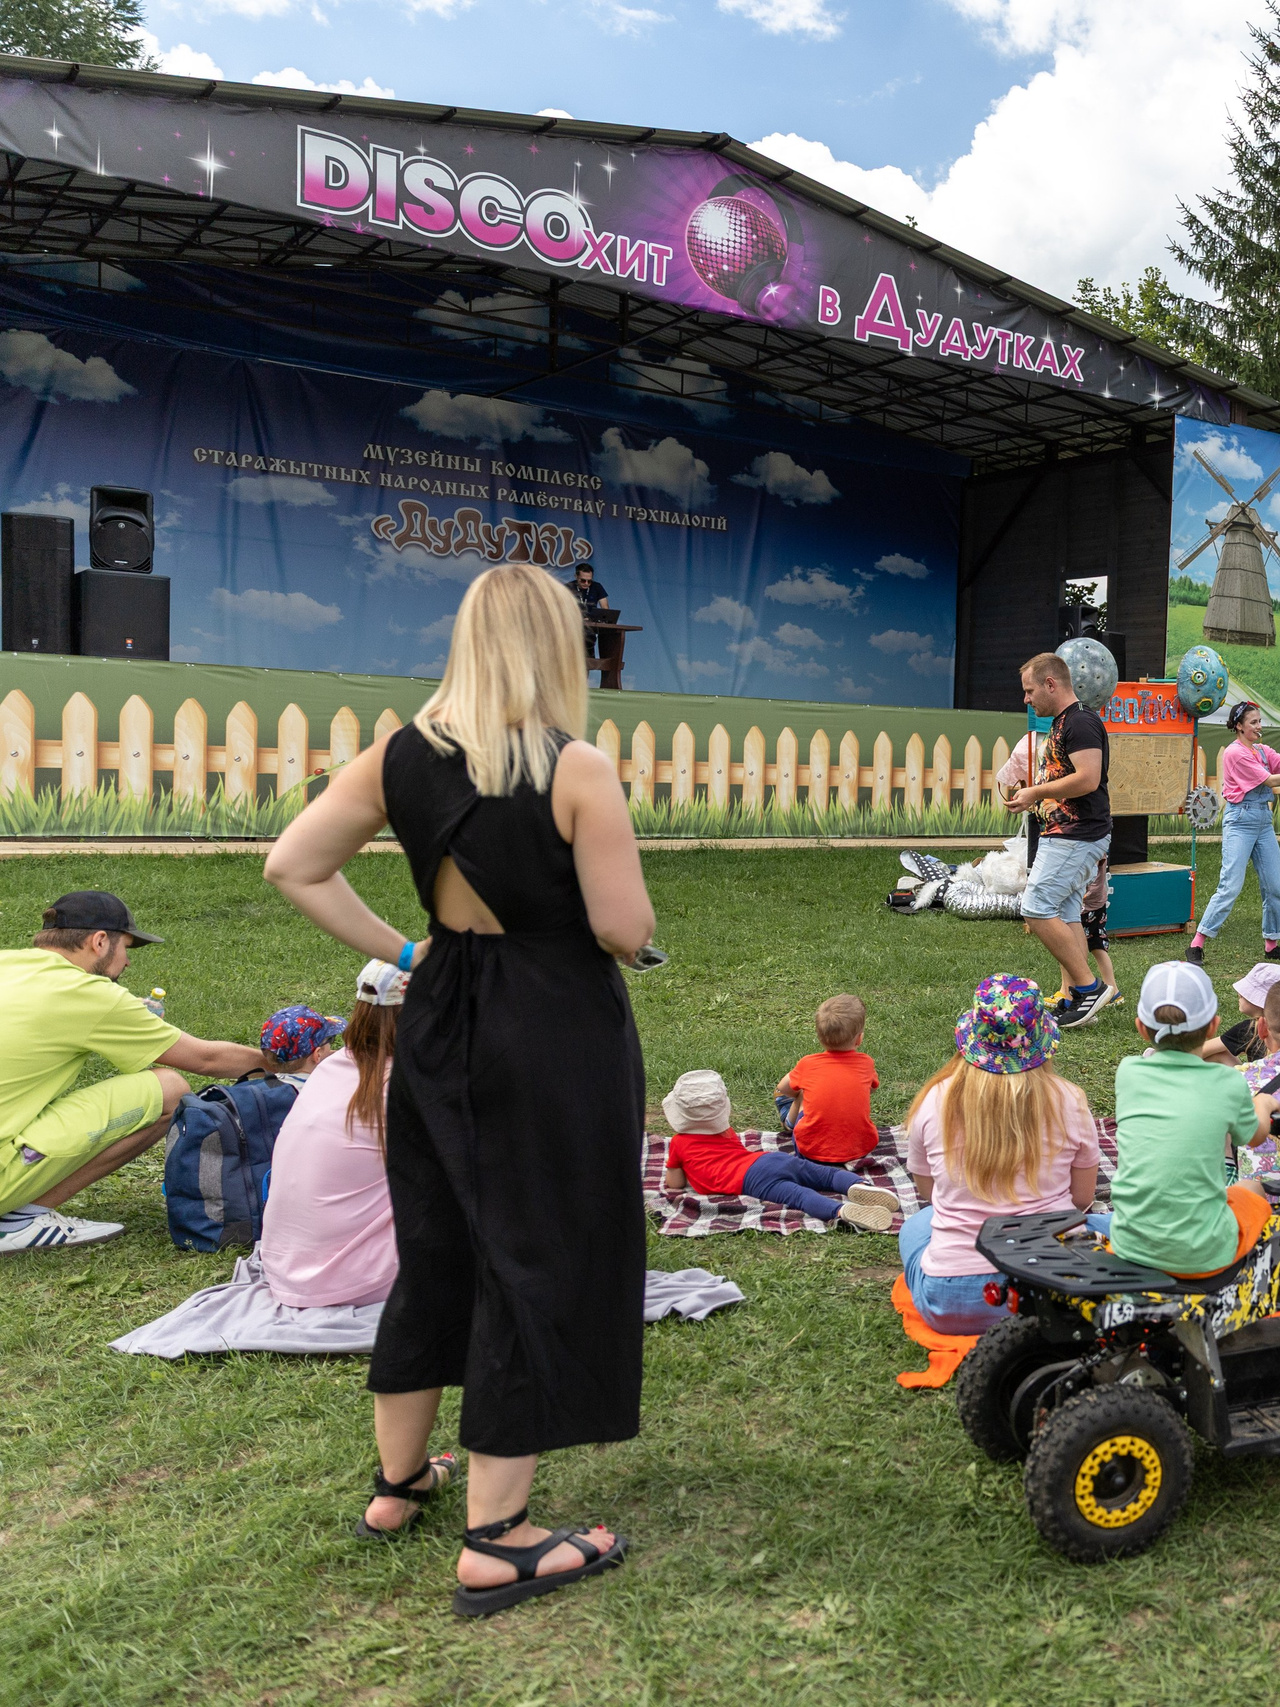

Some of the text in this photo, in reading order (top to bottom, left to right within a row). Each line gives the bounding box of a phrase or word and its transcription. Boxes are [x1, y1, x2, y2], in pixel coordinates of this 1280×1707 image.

[297, 125, 595, 267] DISCO
[193, 447, 371, 485] СТАРАЖЫТНЫХ
[379, 472, 489, 499] НАРОДНЫХ
[497, 488, 605, 518] РАМЁСТВАЎ
[363, 443, 603, 490] МУЗЕЙНЫ КОМПЛЕКС
